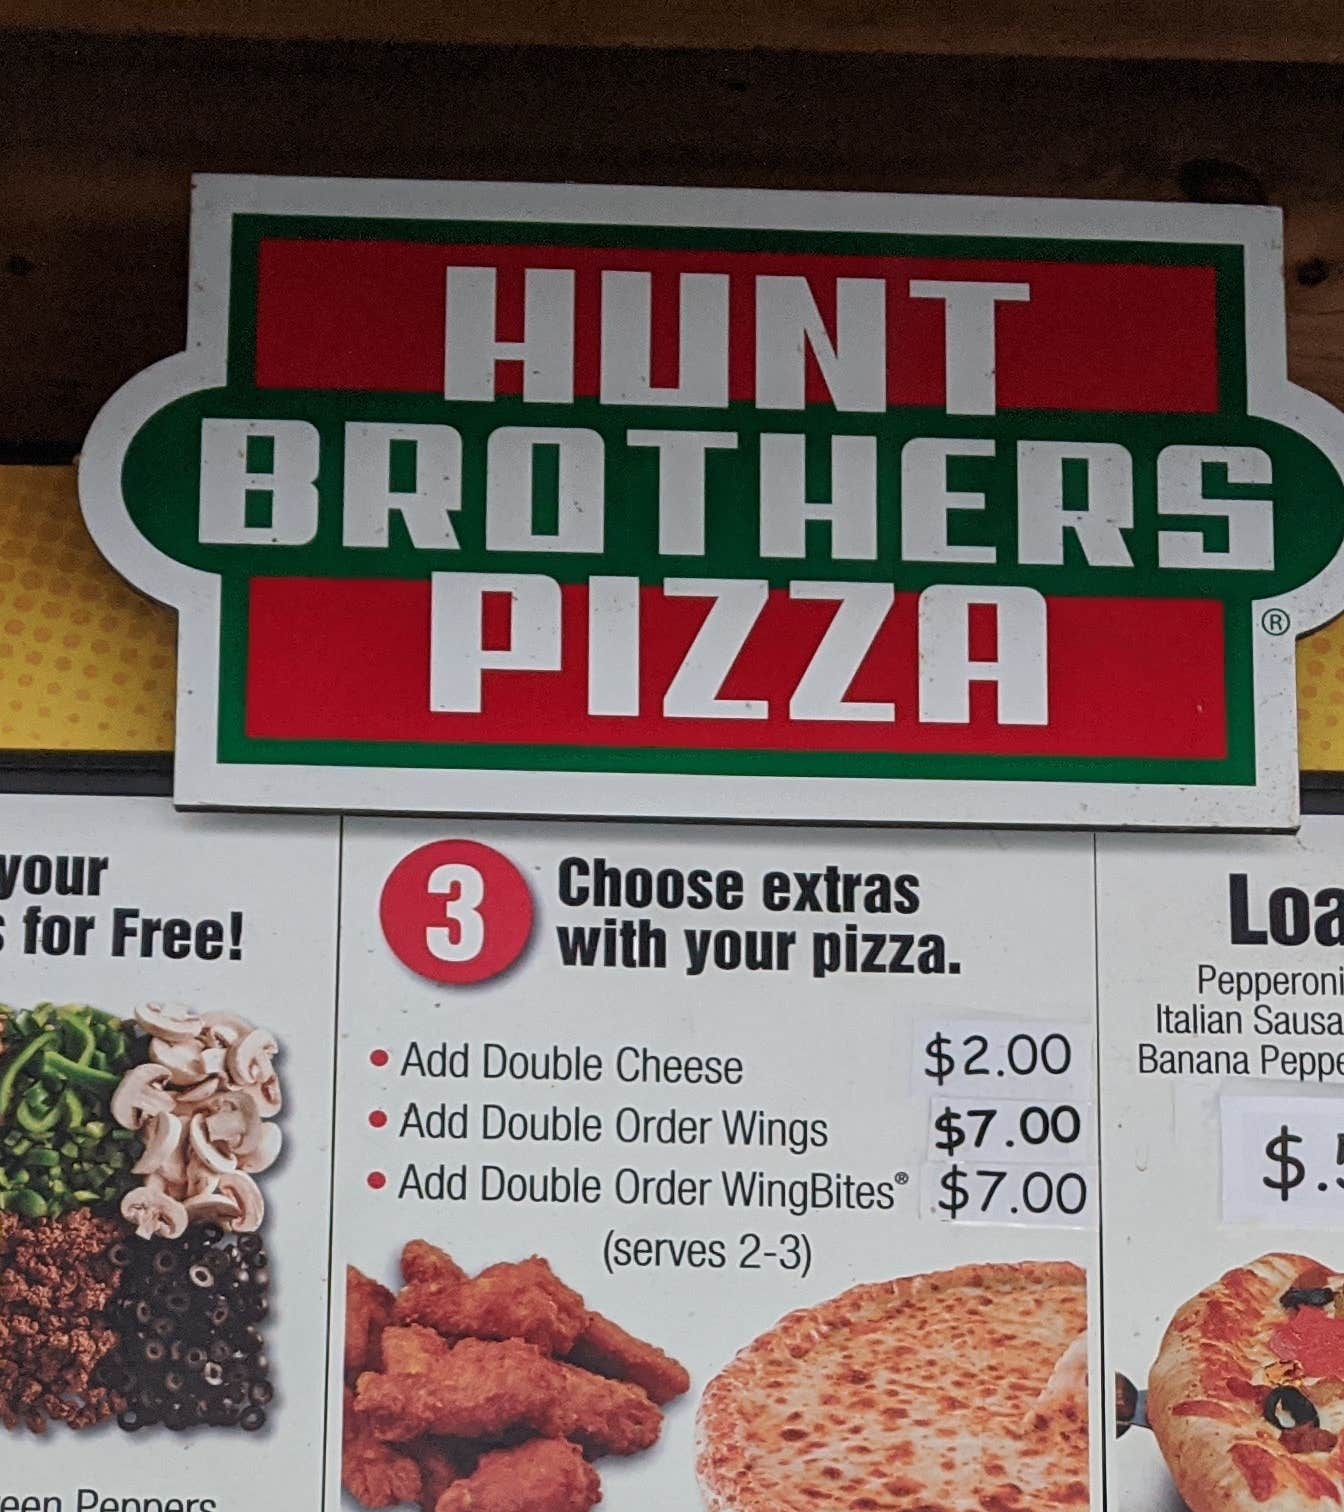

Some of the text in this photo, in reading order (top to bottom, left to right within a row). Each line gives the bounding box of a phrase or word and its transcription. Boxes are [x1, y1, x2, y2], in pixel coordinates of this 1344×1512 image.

[445, 267, 1030, 415] HUNT
[199, 418, 1274, 570] BROTHERS
[430, 572, 1048, 725] PIZZA
[427, 864, 484, 961] 3
[559, 857, 919, 914] Choose extras
[23, 906, 95, 955] for
[112, 908, 242, 960] Free!
[557, 918, 960, 978] with your pizza.
[1157, 1004, 1242, 1034] Italian
[401, 1042, 742, 1084] Add Double Cheese
[925, 1032, 1071, 1086] $2.00
[1139, 1044, 1250, 1074] Banana
[400, 1103, 827, 1154] Add Double Order Wings
[935, 1105, 1080, 1156] $7.00
[398, 1164, 466, 1200] Add
[482, 1166, 600, 1203] Double
[616, 1168, 712, 1205] Order
[939, 1164, 1086, 1219] $7.00
[604, 1230, 811, 1278] (serves 2-3)
